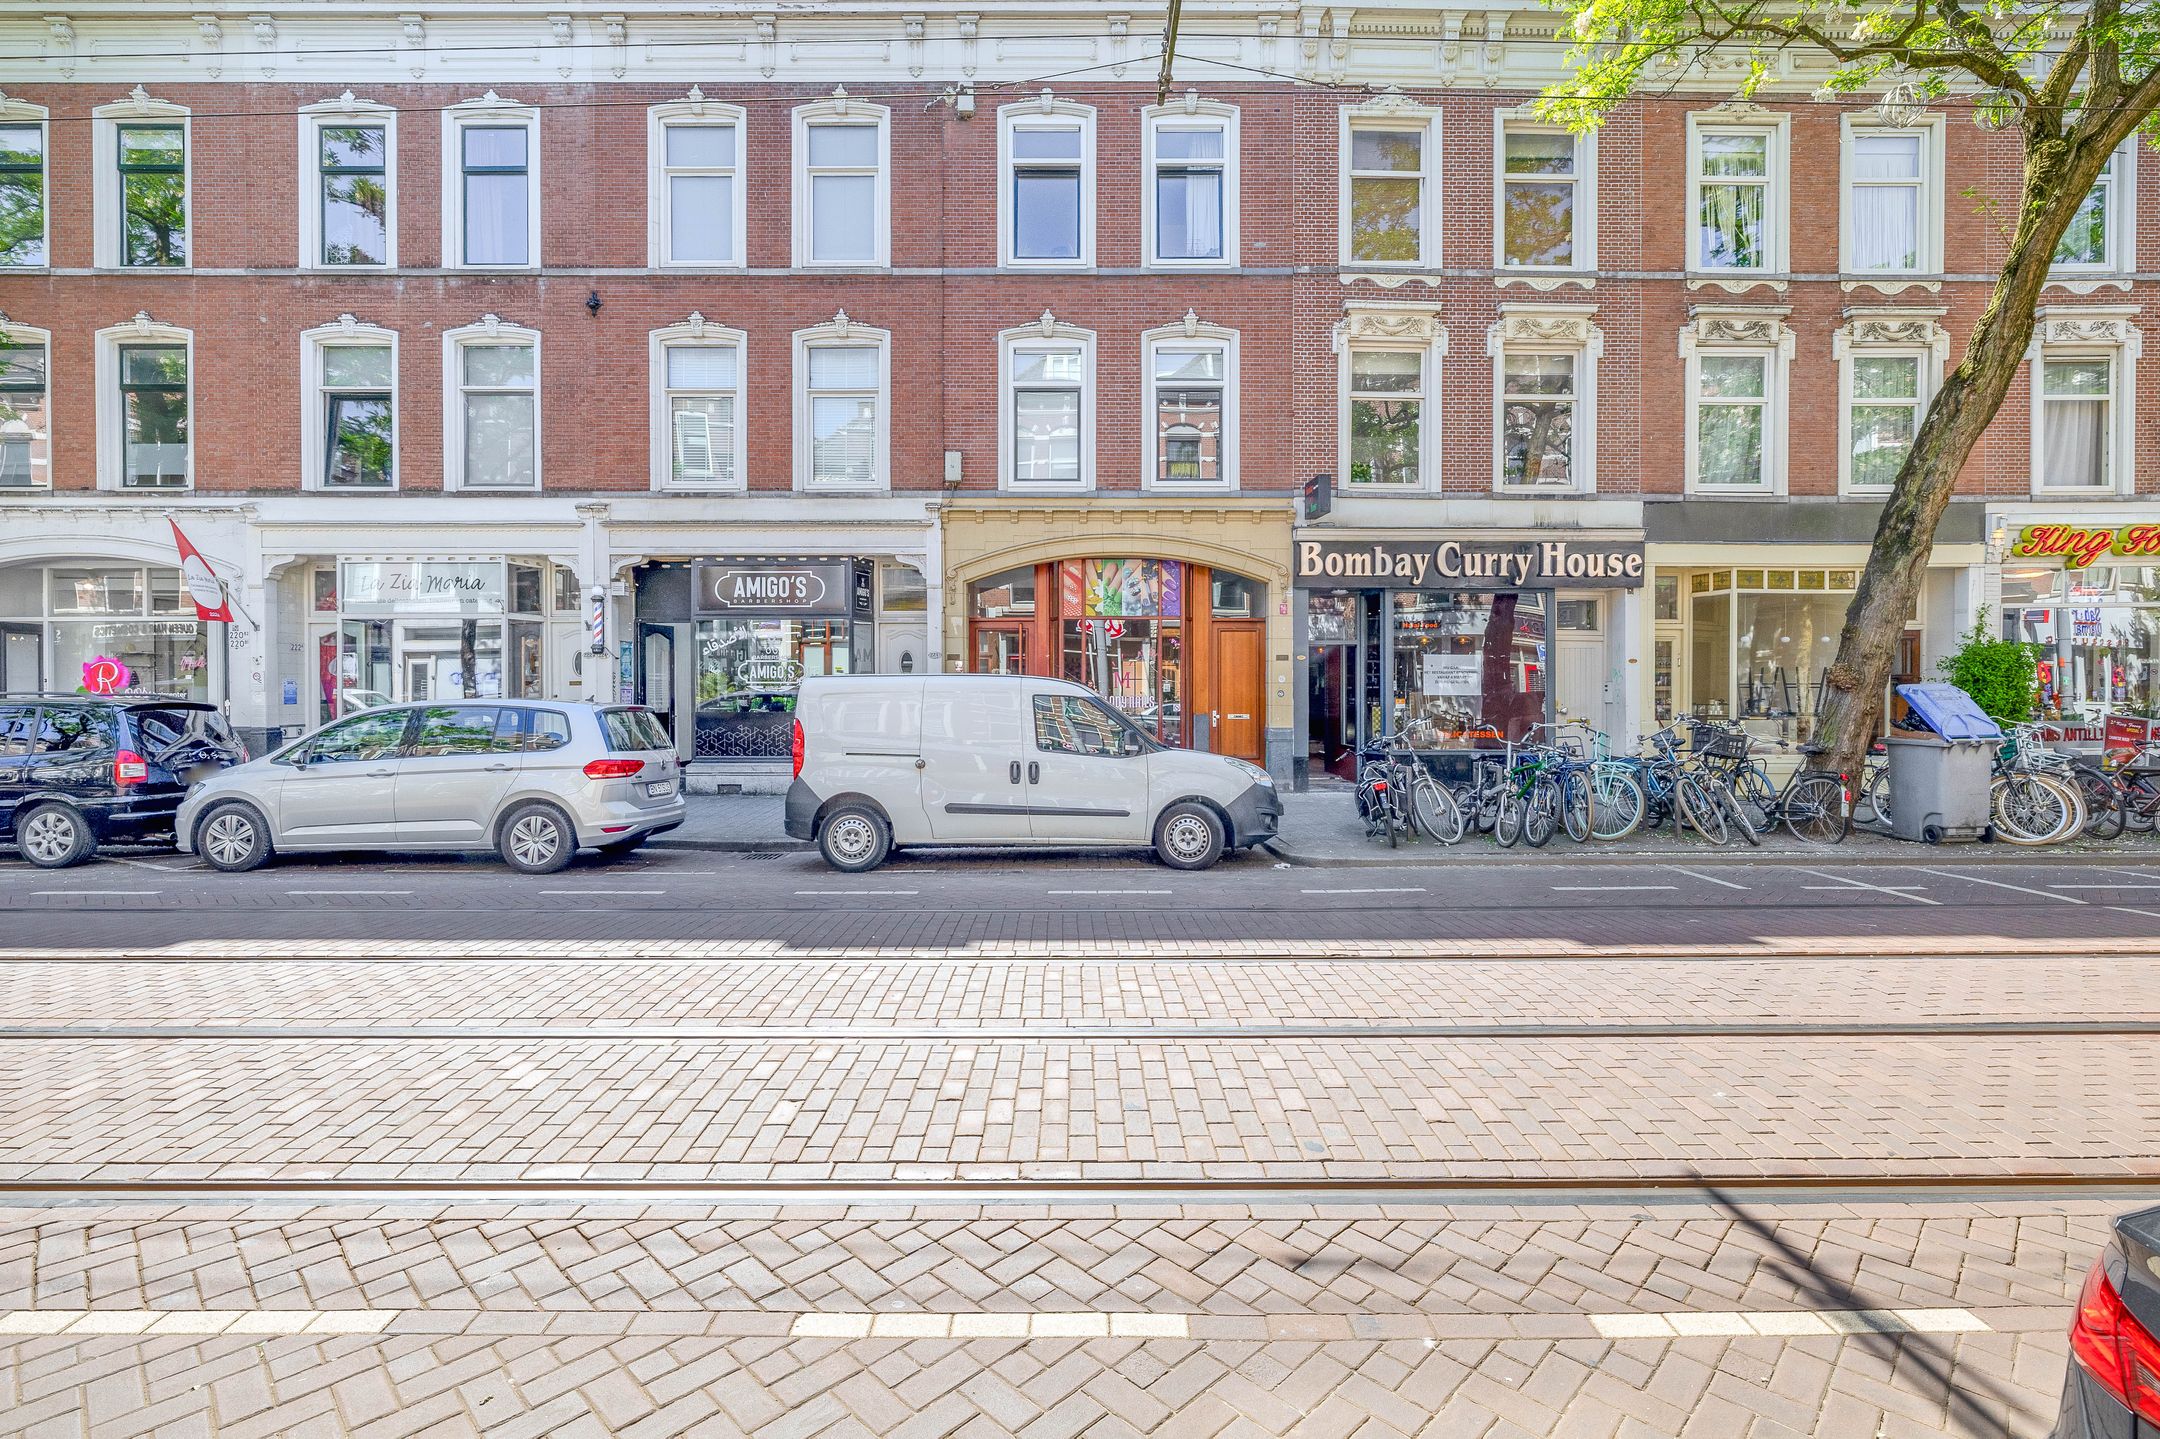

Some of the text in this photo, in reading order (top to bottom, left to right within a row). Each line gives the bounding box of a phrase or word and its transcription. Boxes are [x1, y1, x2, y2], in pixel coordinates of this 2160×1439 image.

[1299, 541, 1643, 585] Bombay Curry House
[2020, 525, 2113, 568] King
[733, 576, 807, 598] AMIGO'S
